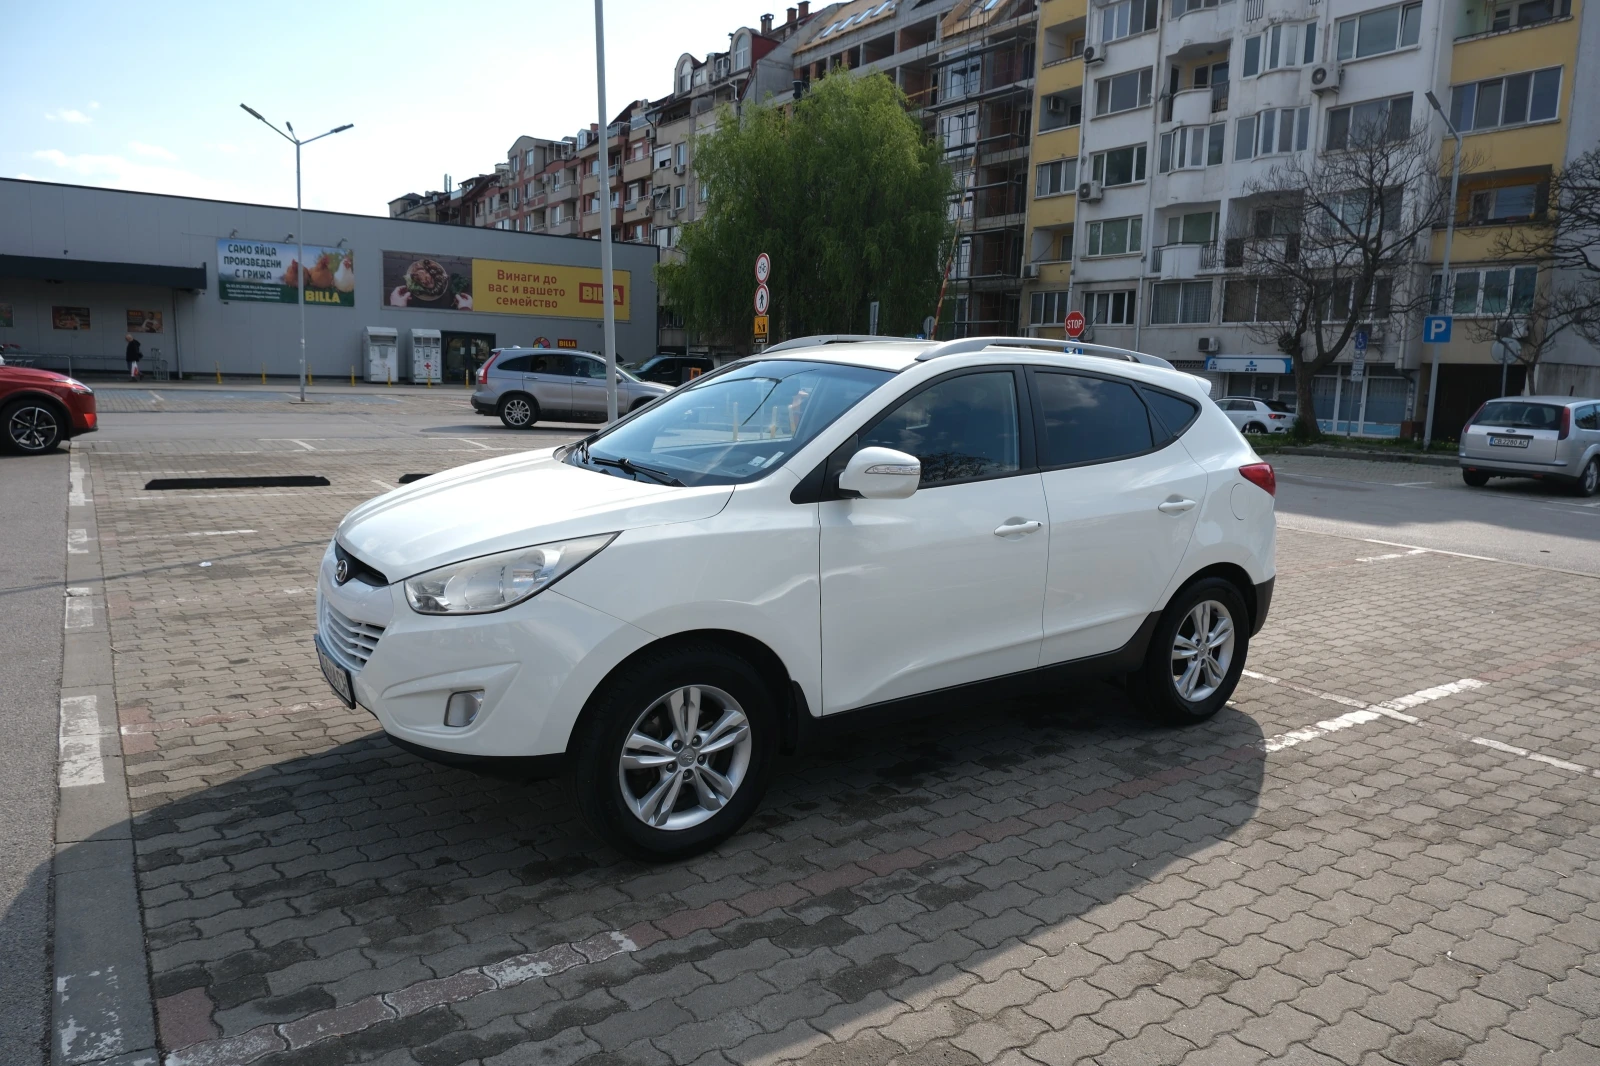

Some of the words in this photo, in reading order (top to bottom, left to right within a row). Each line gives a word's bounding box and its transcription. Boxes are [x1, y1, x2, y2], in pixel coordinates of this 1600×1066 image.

[228, 244, 252, 254] САМО
[254, 244, 277, 257] ЯЙЦА
[223, 256, 282, 268] ПРОИЗВЕДЕНИ
[235, 269, 240, 278] С
[243, 269, 272, 280] ГРИЖА
[497, 269, 540, 283] Винаги
[543, 276, 557, 285] до
[305, 290, 341, 303] BILLA
[488, 284, 508, 293] вас
[512, 286, 519, 294] и
[523, 286, 566, 297] вашето
[582, 286, 621, 302] BILA
[496, 296, 558, 309] семейство
[1067, 319, 1083, 329] STOP
[1430, 320, 1447, 340] P
